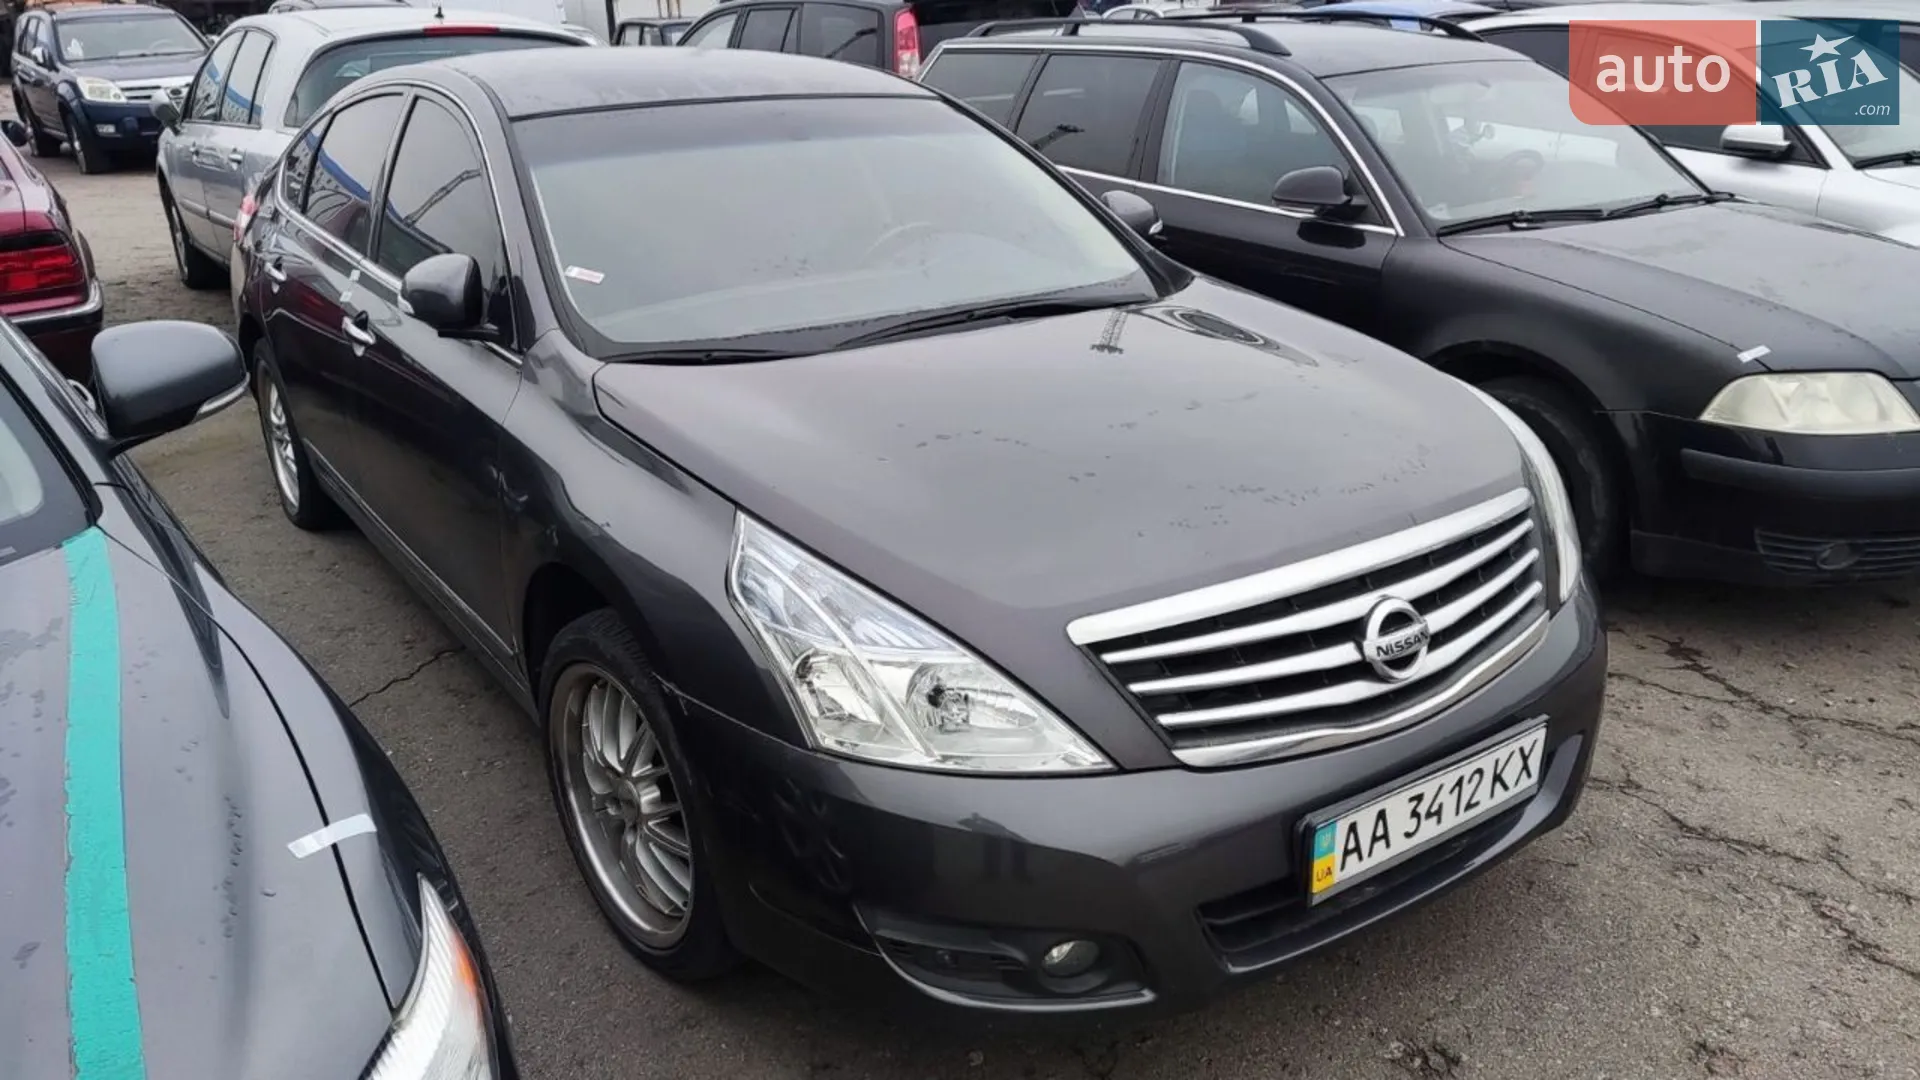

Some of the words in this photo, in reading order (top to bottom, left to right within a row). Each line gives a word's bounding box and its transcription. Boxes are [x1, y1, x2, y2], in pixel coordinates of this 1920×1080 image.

[1376, 631, 1429, 657] NISSAN
[1340, 808, 1391, 872] AA
[1315, 867, 1333, 883] UA
